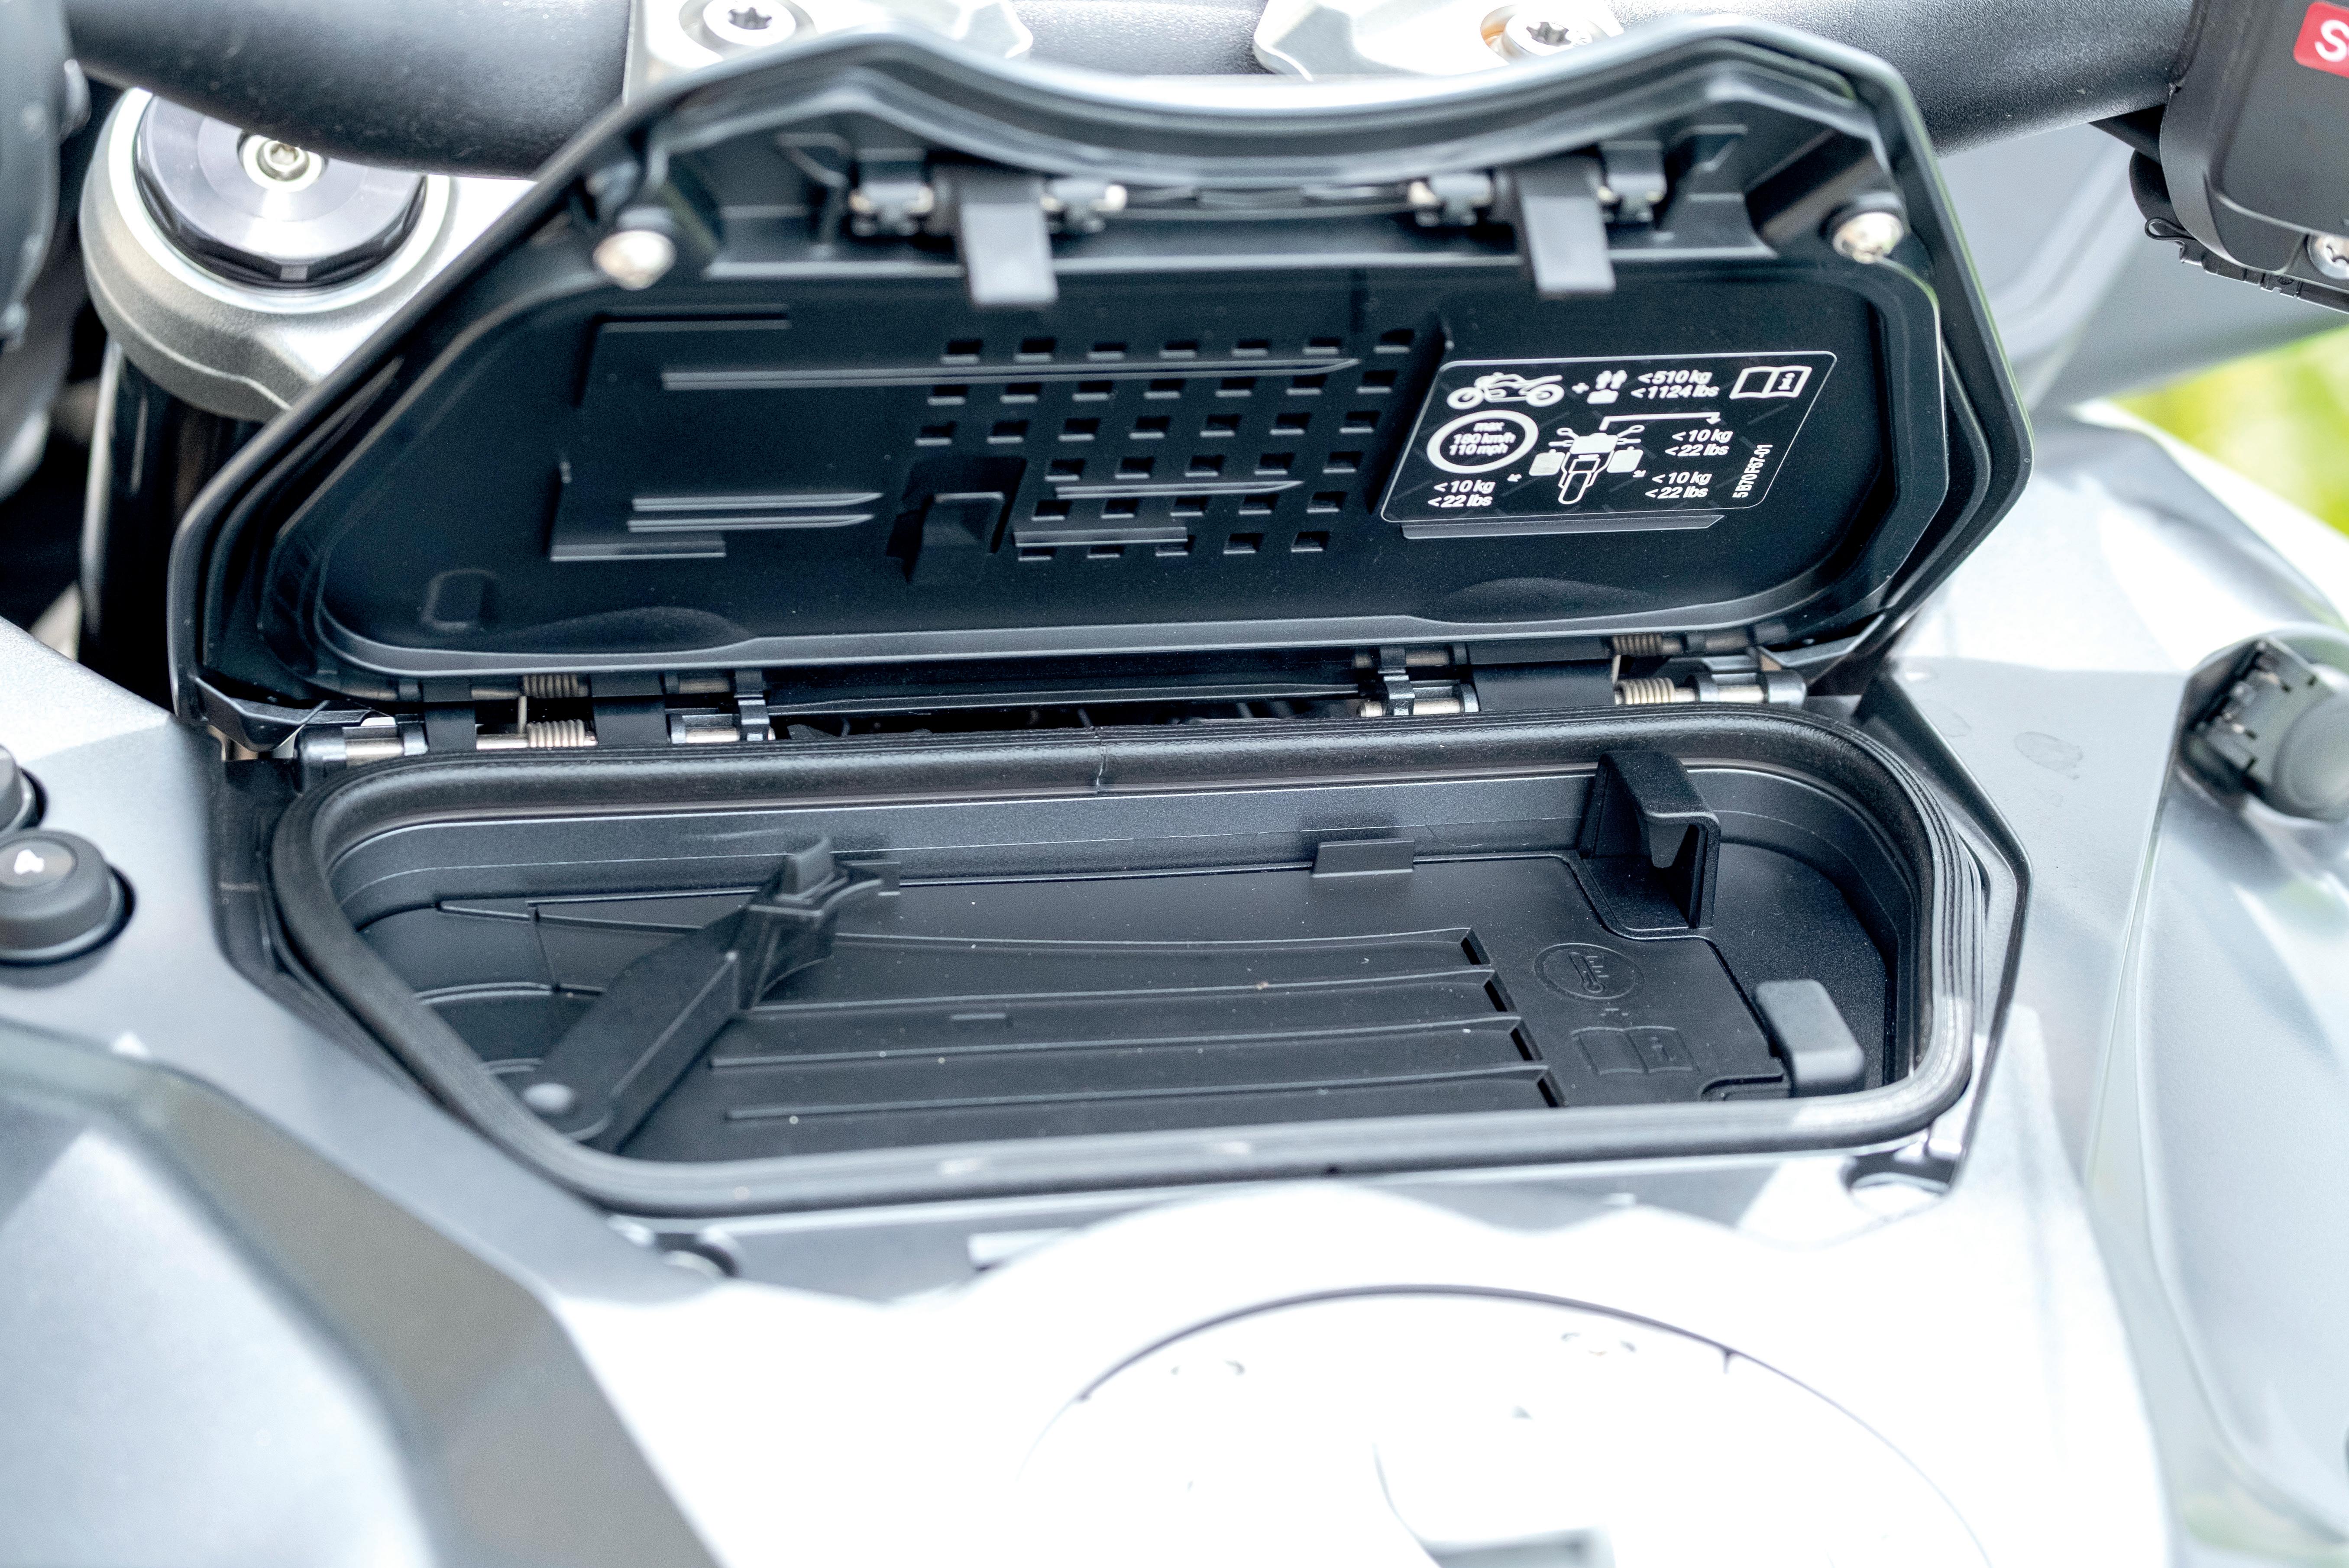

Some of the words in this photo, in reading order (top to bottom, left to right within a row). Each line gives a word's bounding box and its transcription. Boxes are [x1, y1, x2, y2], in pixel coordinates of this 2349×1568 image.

[2314, 19, 2349, 62] S
[1688, 369, 1713, 385] kg
[1692, 384, 1720, 398] lbs
[1473, 422, 1505, 432] max
[1710, 429, 1733, 443] kg
[1449, 443, 1477, 456] 110
[1476, 443, 1509, 456] mph
[1703, 443, 1729, 456] lbs
[1689, 471, 1712, 485] kg
[1472, 479, 1496, 494] kg
[1682, 486, 1708, 498] lbs
[1466, 494, 1493, 507] lbs
